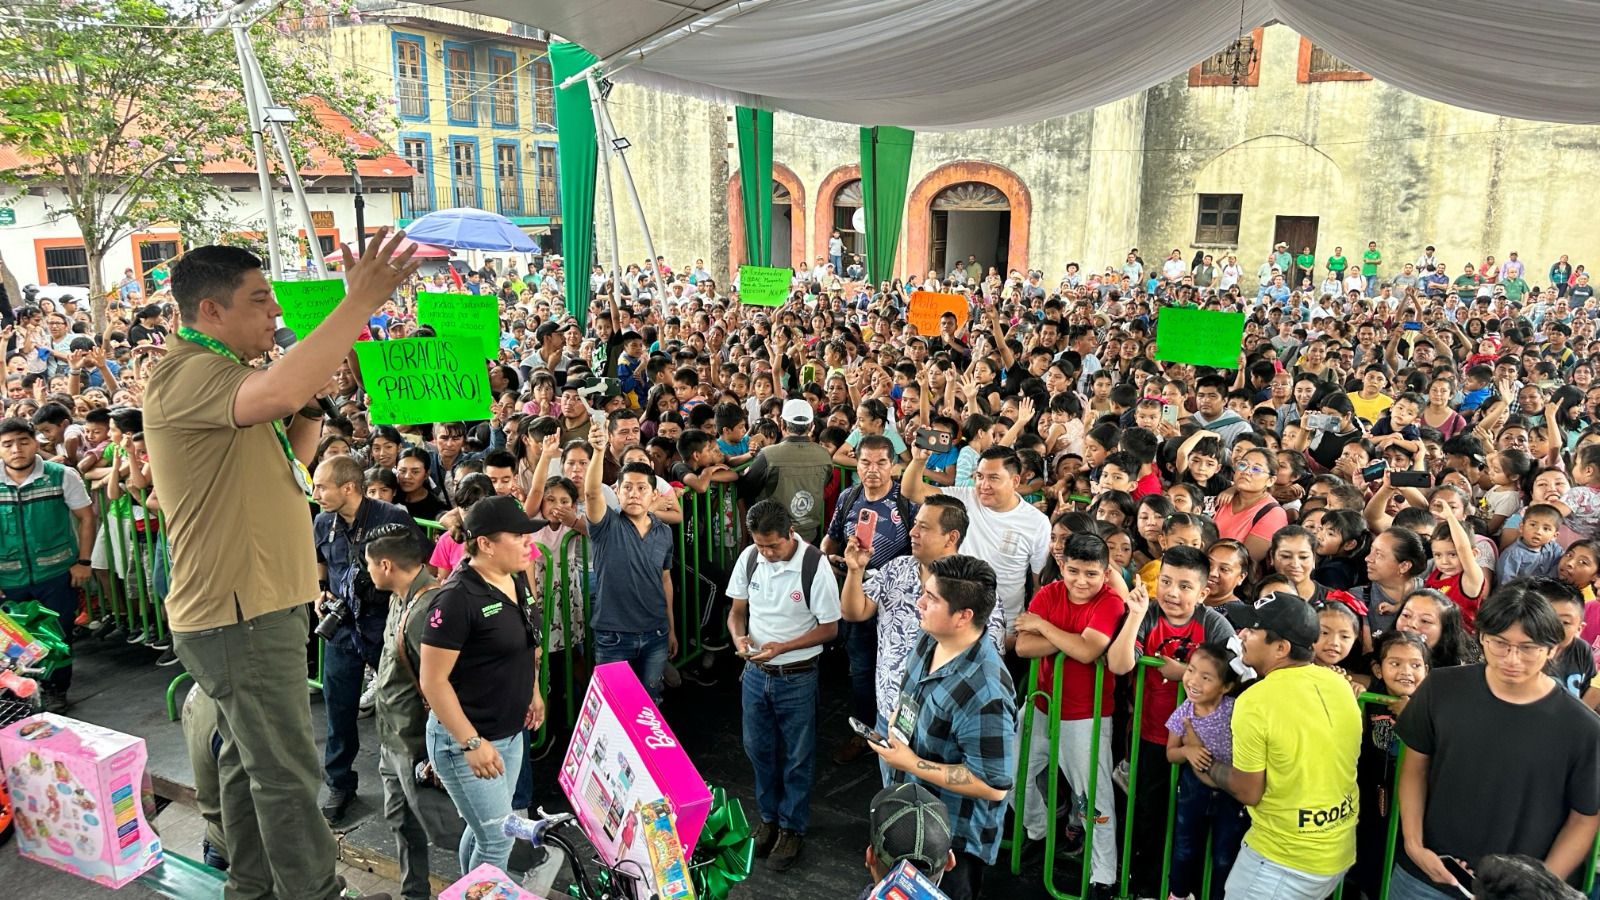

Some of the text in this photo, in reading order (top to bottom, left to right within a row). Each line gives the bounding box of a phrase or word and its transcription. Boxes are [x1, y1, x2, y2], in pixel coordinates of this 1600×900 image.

[380, 341, 459, 373] ¡GRACIAS
[377, 372, 482, 404] PADRINO!
[635, 706, 676, 750] Barbie
[900, 703, 916, 725] STAFF
